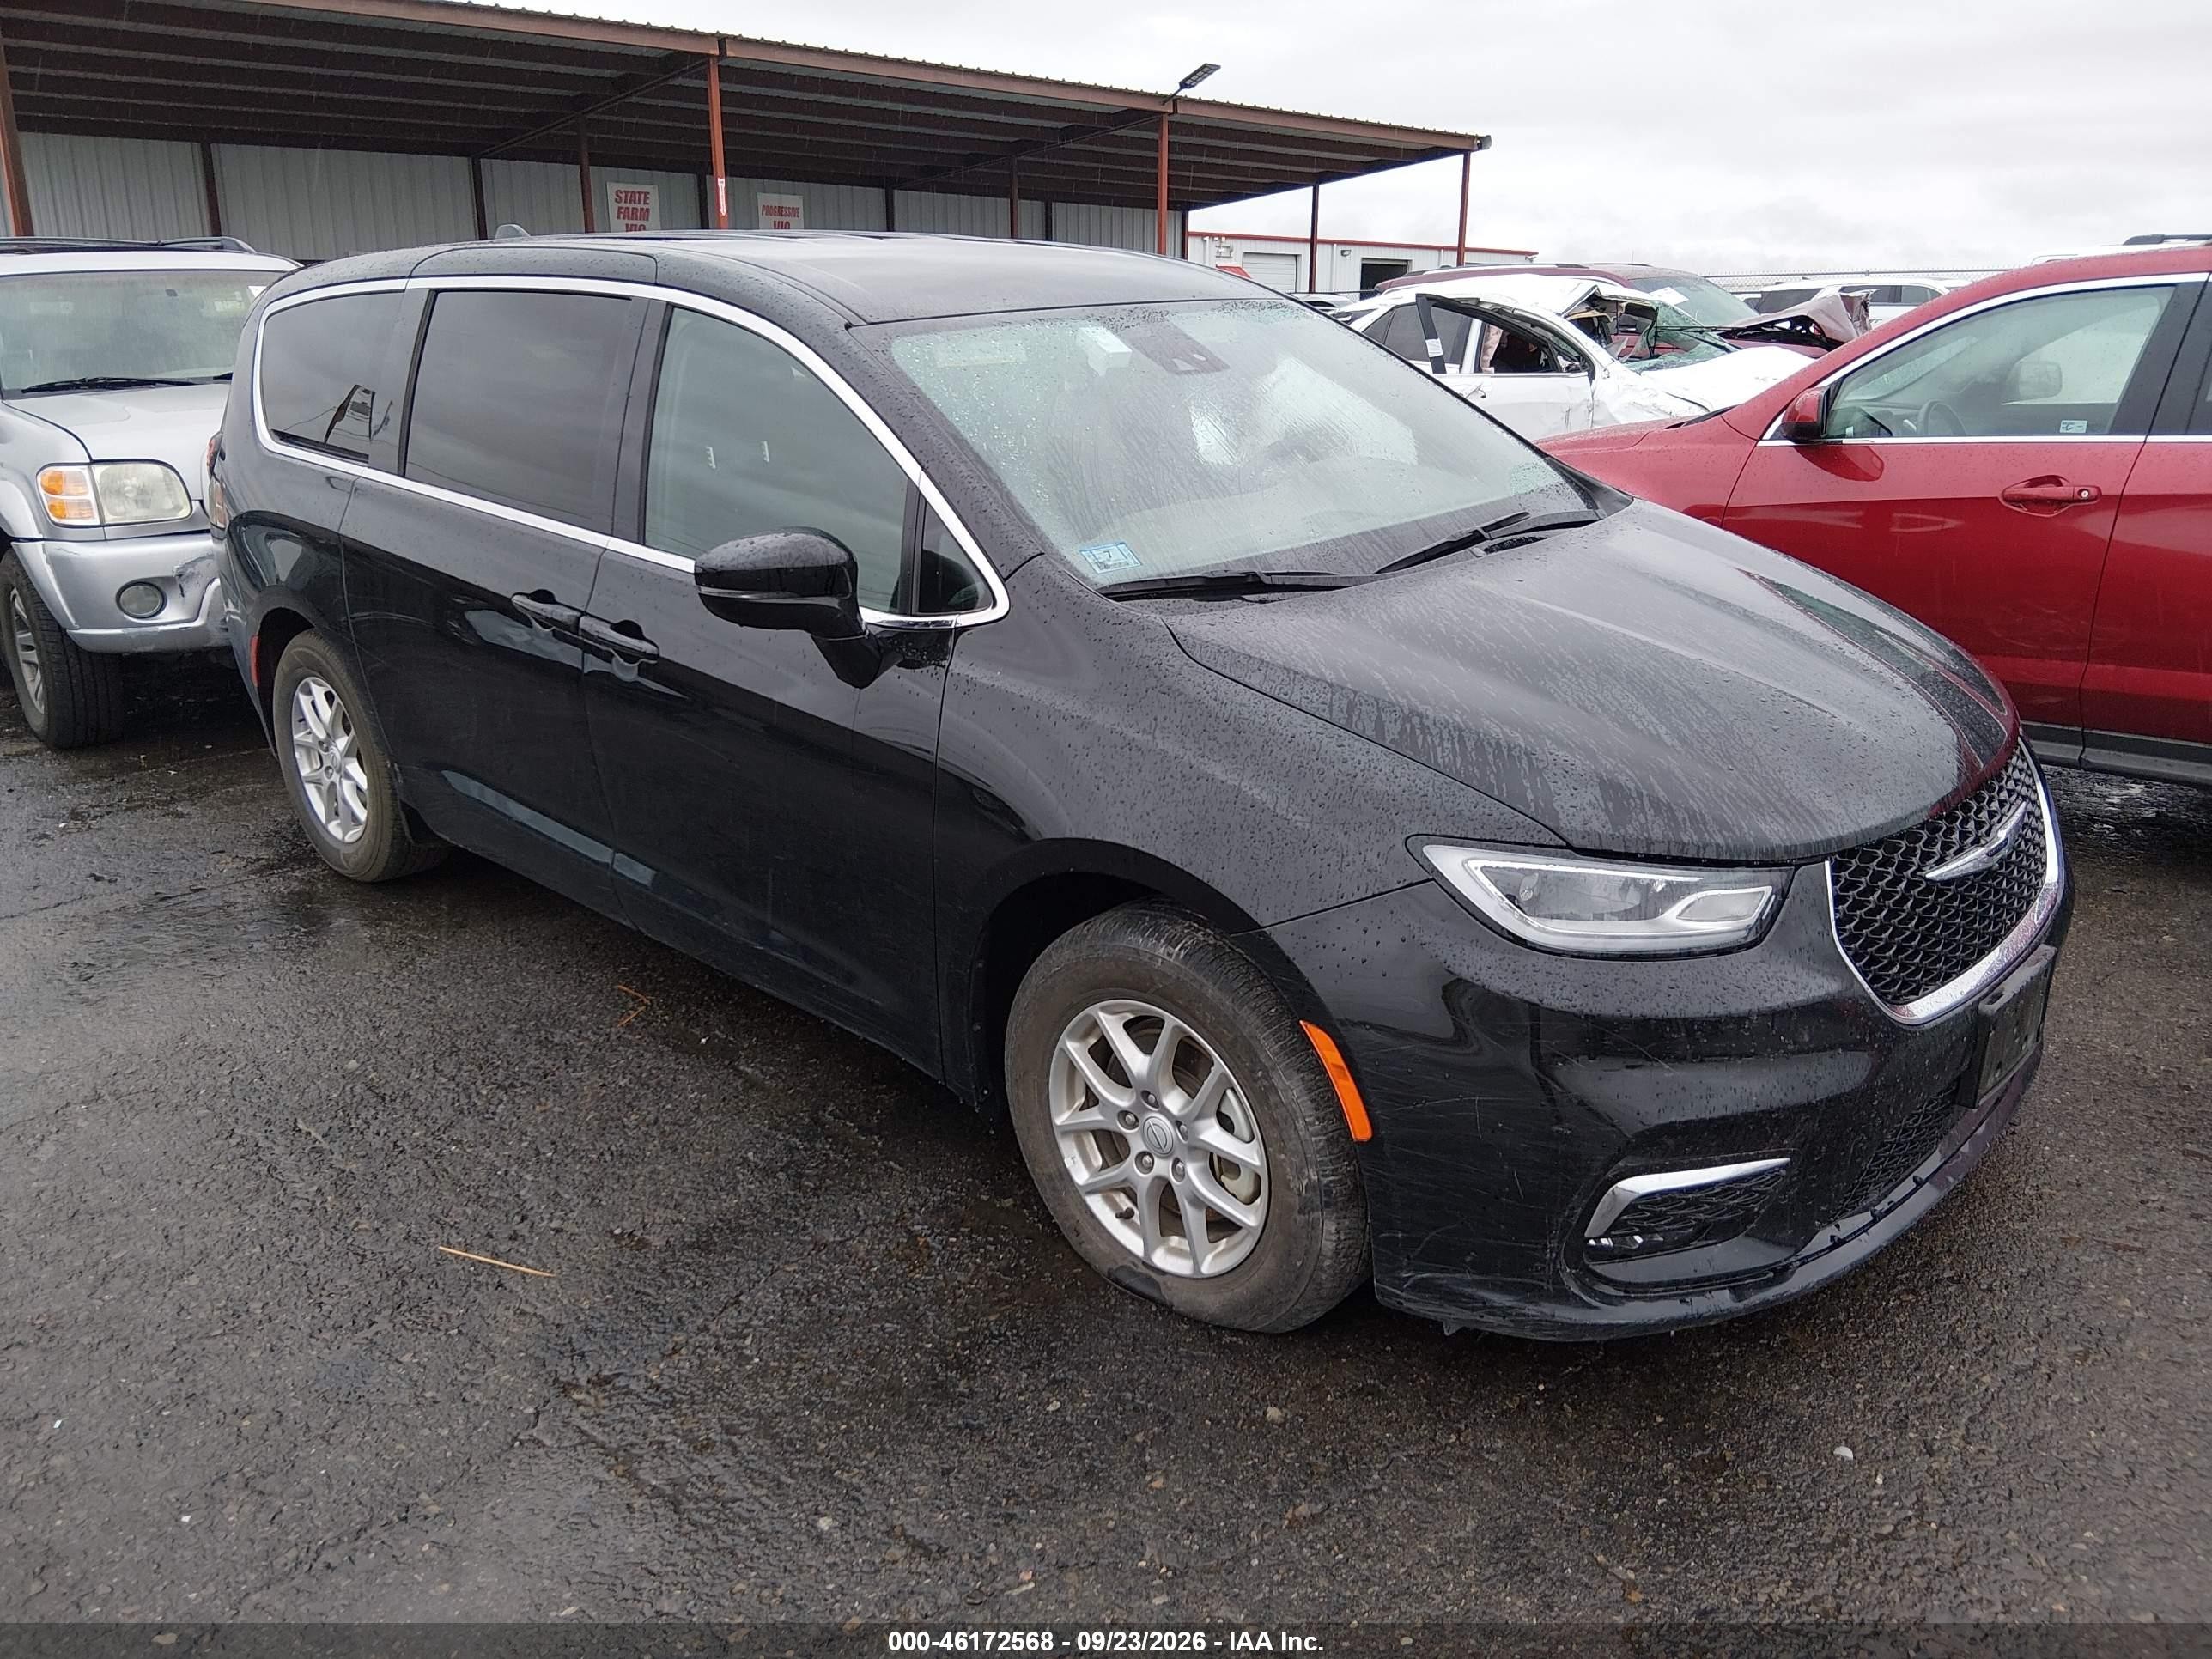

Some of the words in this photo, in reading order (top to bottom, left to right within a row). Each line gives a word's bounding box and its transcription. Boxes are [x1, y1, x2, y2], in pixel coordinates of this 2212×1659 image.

[614, 189, 651, 205] STATE
[617, 206, 651, 222] FARM
[761, 204, 801, 219] PROGRESSIVE
